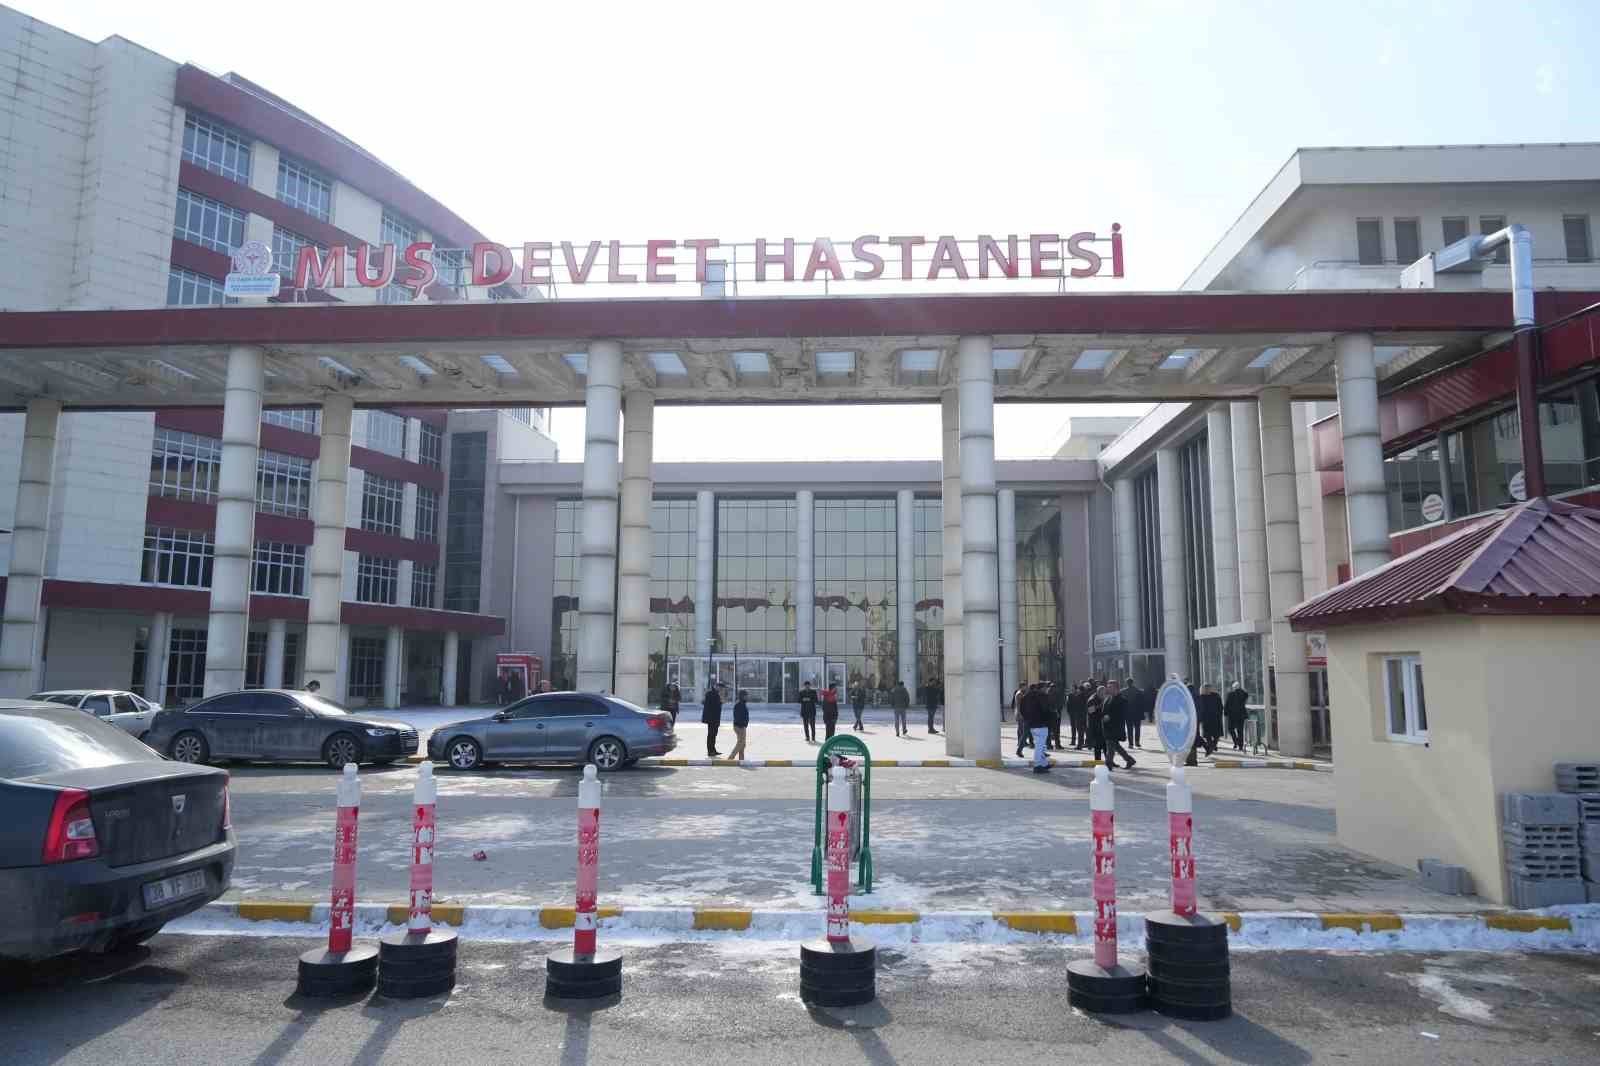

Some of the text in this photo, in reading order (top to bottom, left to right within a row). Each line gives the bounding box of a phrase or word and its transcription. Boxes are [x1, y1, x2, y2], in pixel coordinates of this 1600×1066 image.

[294, 222, 1126, 301] MUŞ DEVLET HASTANESİ
